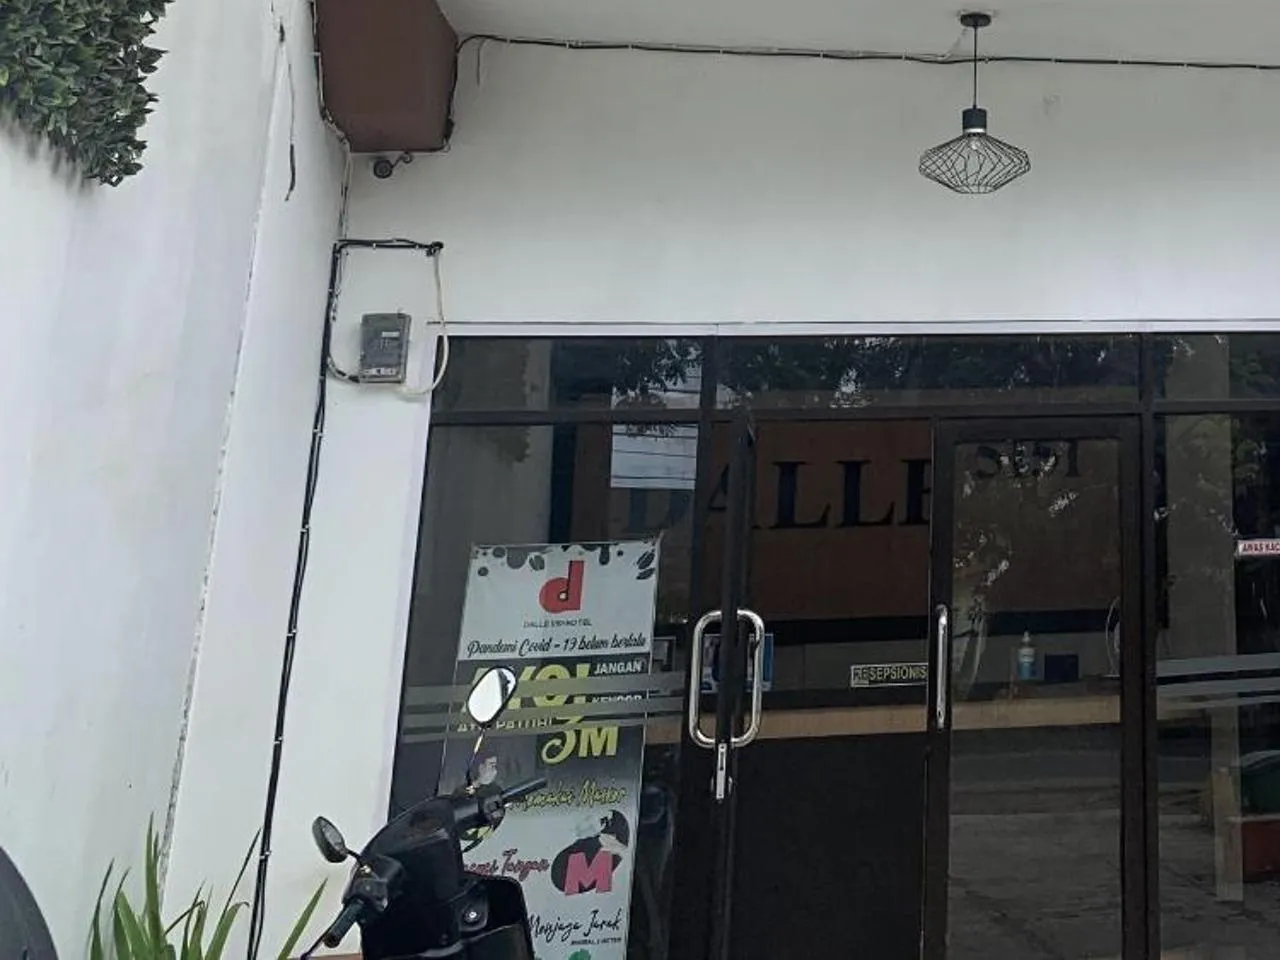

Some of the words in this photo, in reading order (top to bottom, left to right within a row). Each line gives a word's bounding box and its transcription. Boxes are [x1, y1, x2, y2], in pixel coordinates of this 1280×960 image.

[518, 637, 551, 657] Covid
[594, 660, 643, 676] JANGAN
[564, 851, 613, 897] M
